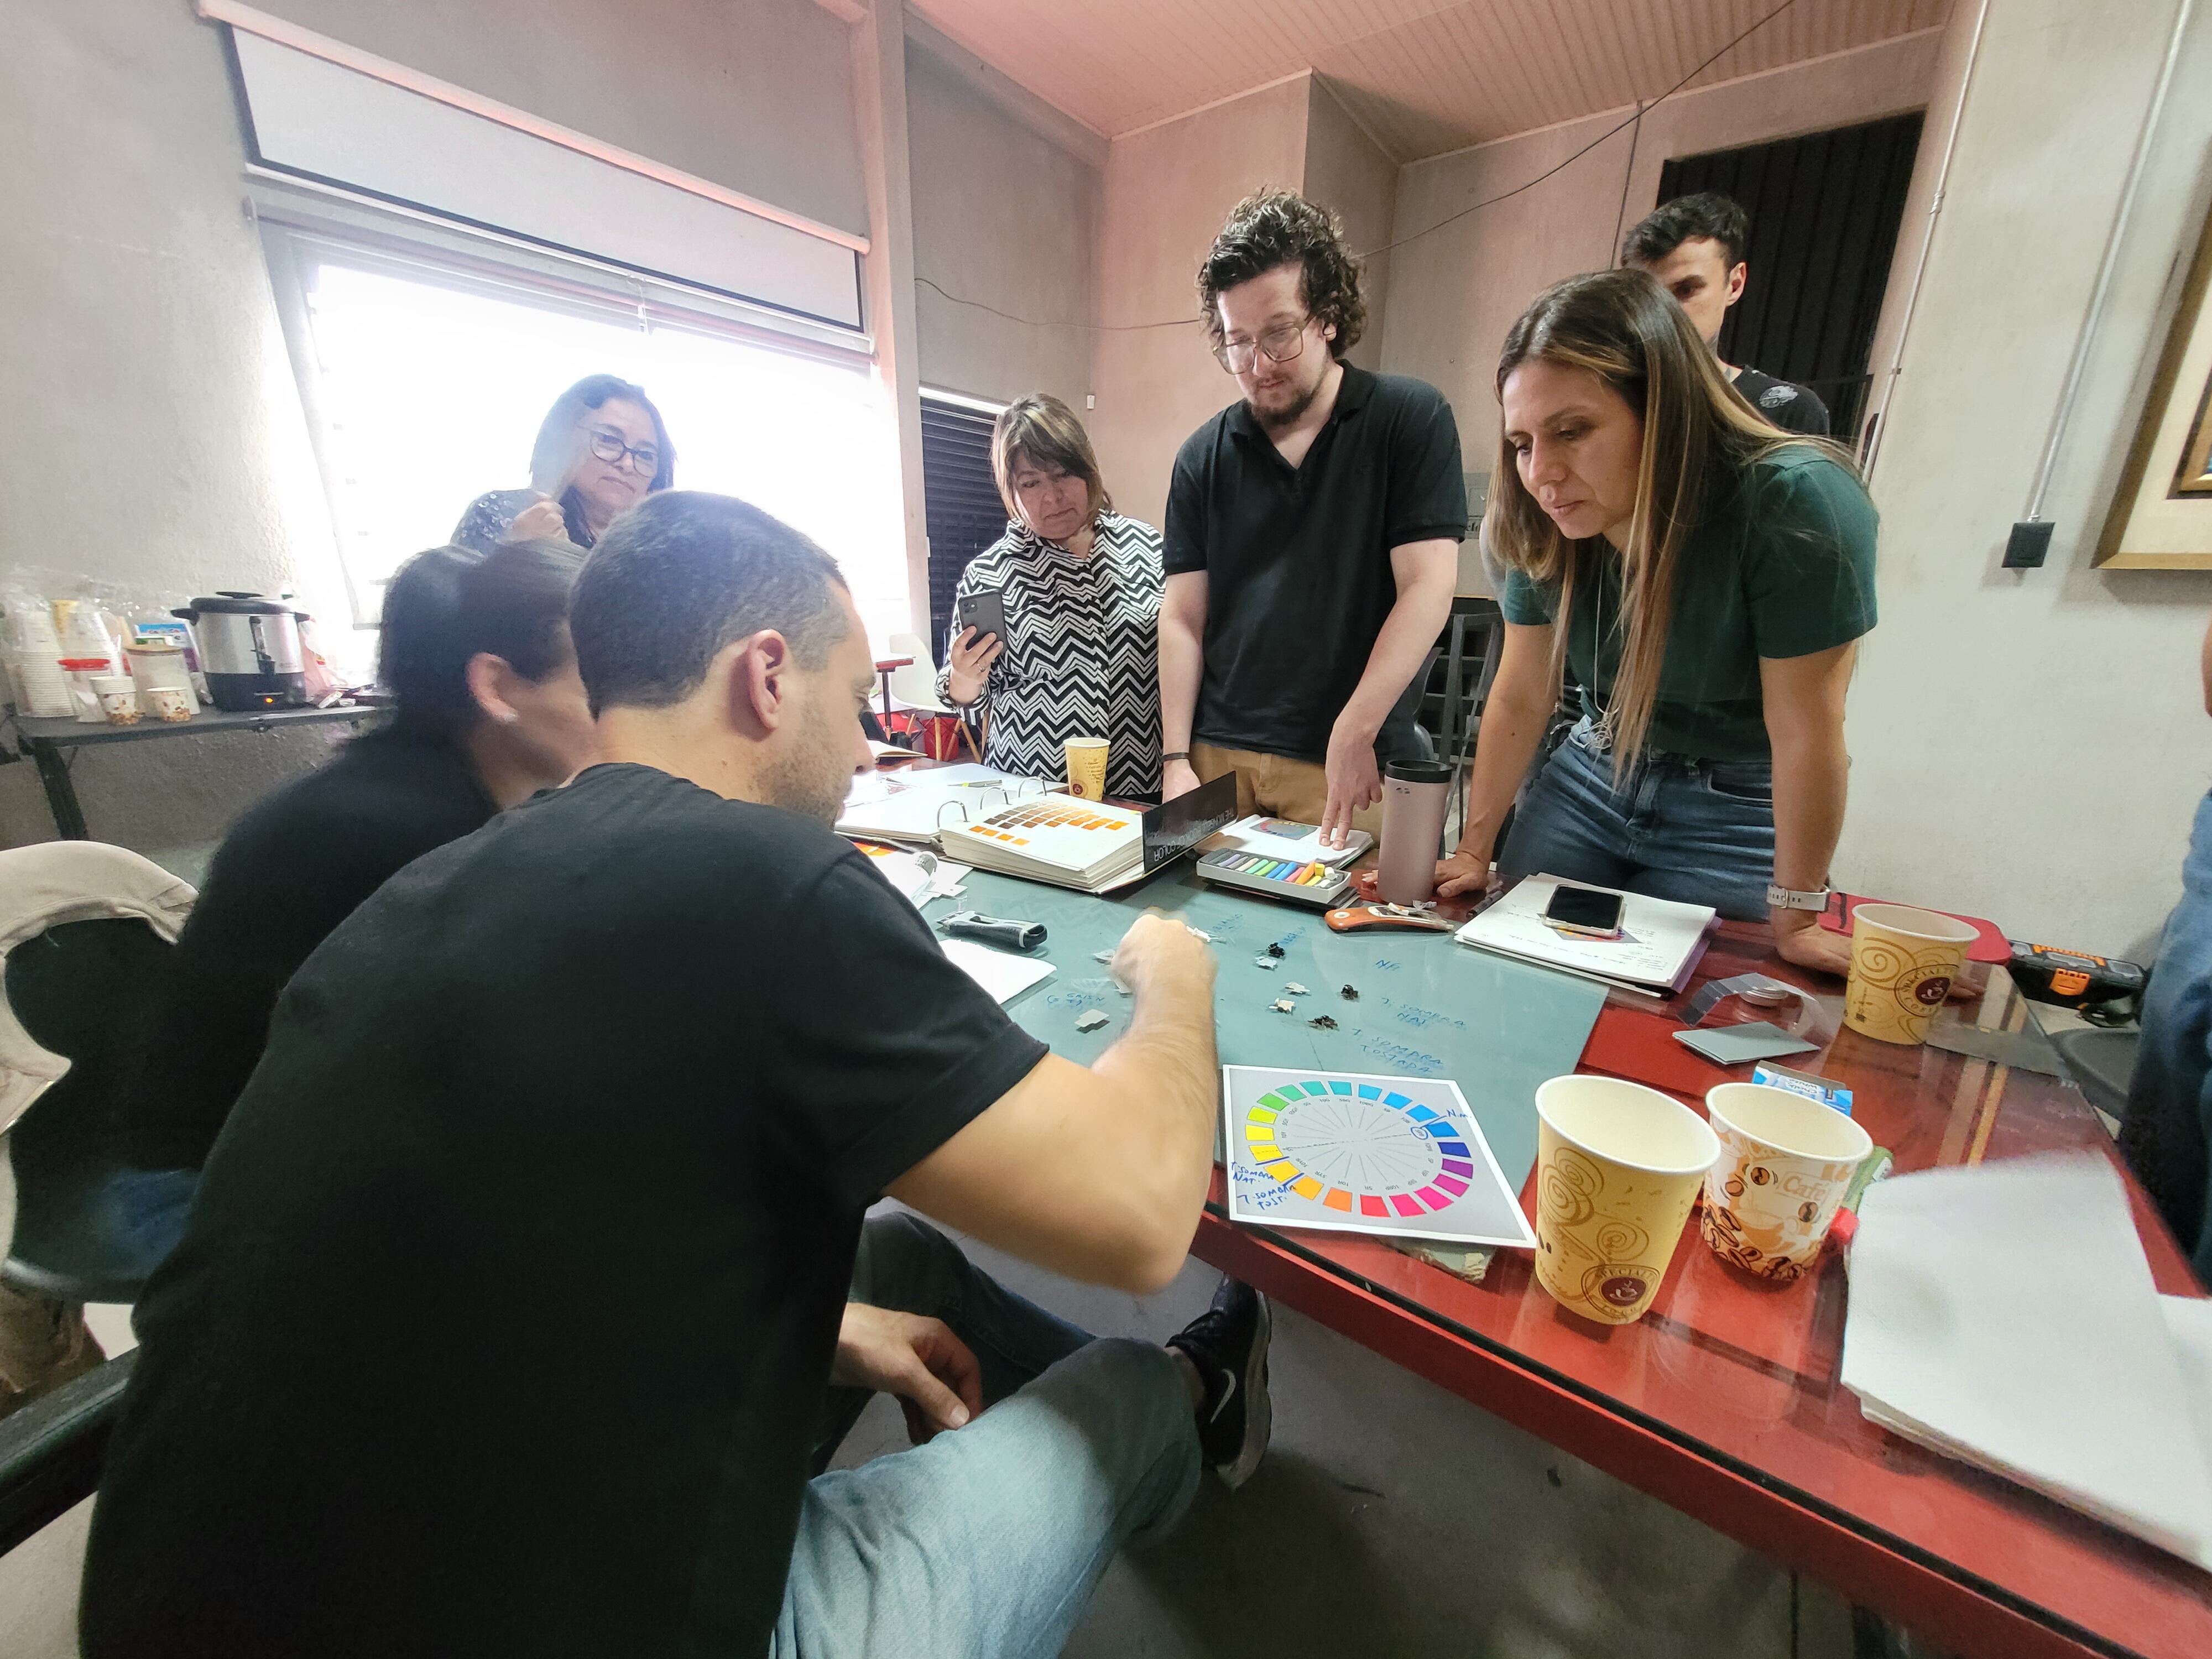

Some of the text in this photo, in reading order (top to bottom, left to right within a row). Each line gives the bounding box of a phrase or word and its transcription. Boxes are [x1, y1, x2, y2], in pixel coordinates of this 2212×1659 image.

[1154, 840, 1176, 862] COLOR
[1787, 1082, 1818, 1094] Chalk
[1296, 1157, 1308, 1168] 10YR
[1783, 1176, 1829, 1201] Café
